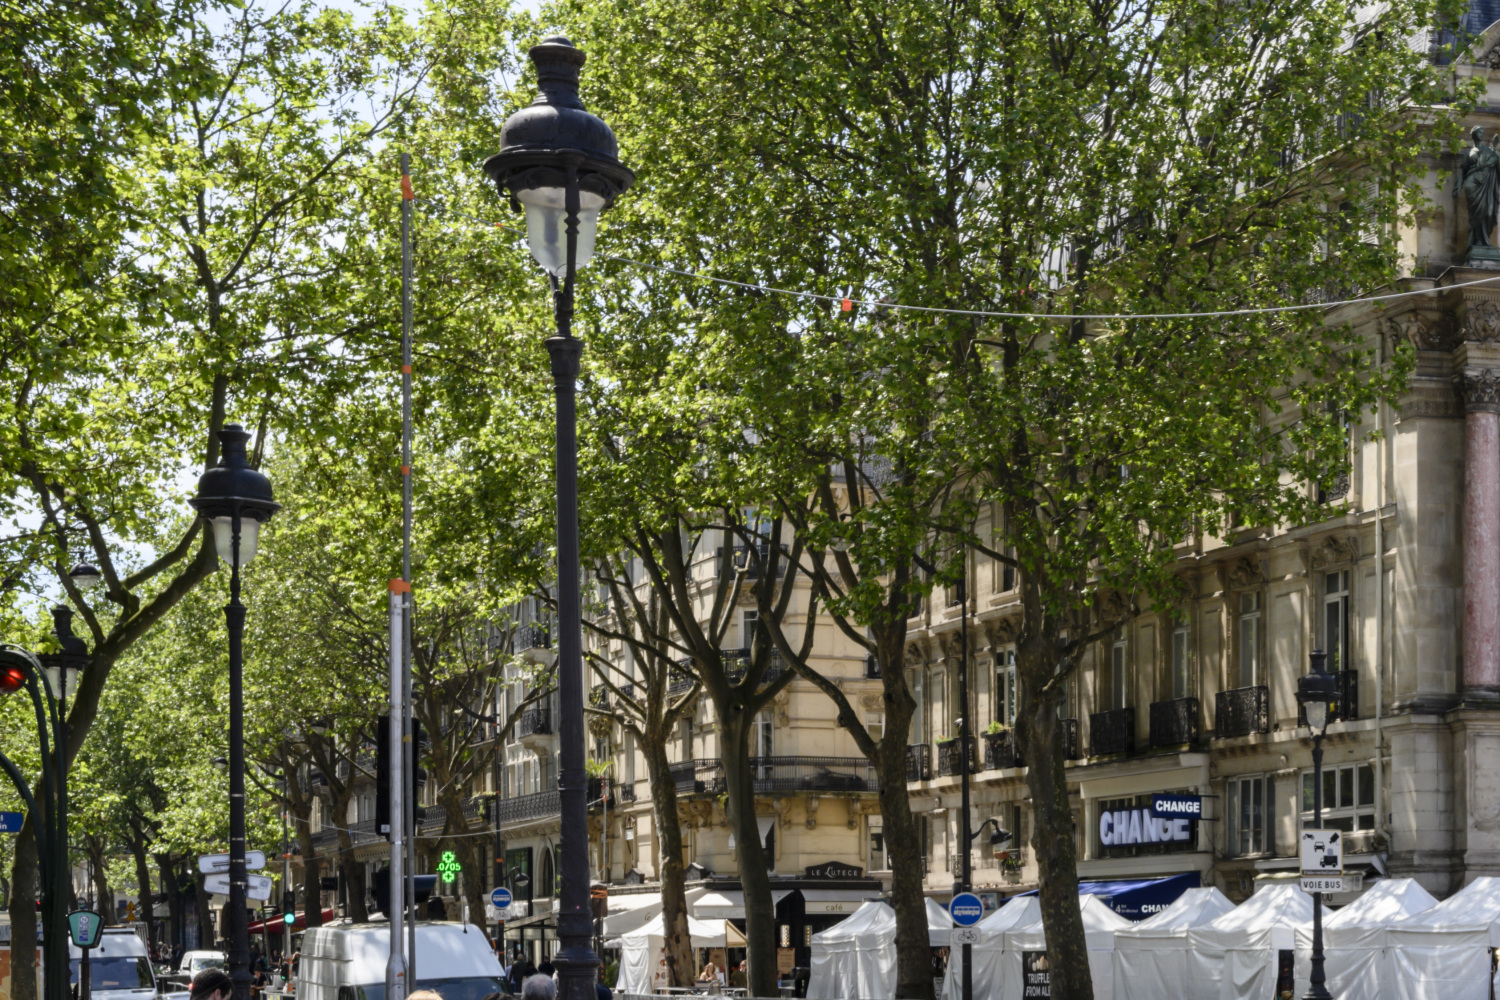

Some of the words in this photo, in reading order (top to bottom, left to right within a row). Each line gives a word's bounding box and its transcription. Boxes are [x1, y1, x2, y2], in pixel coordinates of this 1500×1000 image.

[1155, 800, 1200, 813] CHANGE
[1100, 808, 1190, 846] CHANGE
[1303, 881, 1322, 889] VOIE
[1325, 881, 1341, 889] BUS
[826, 904, 843, 912] café
[1026, 986, 1041, 997] FROM
